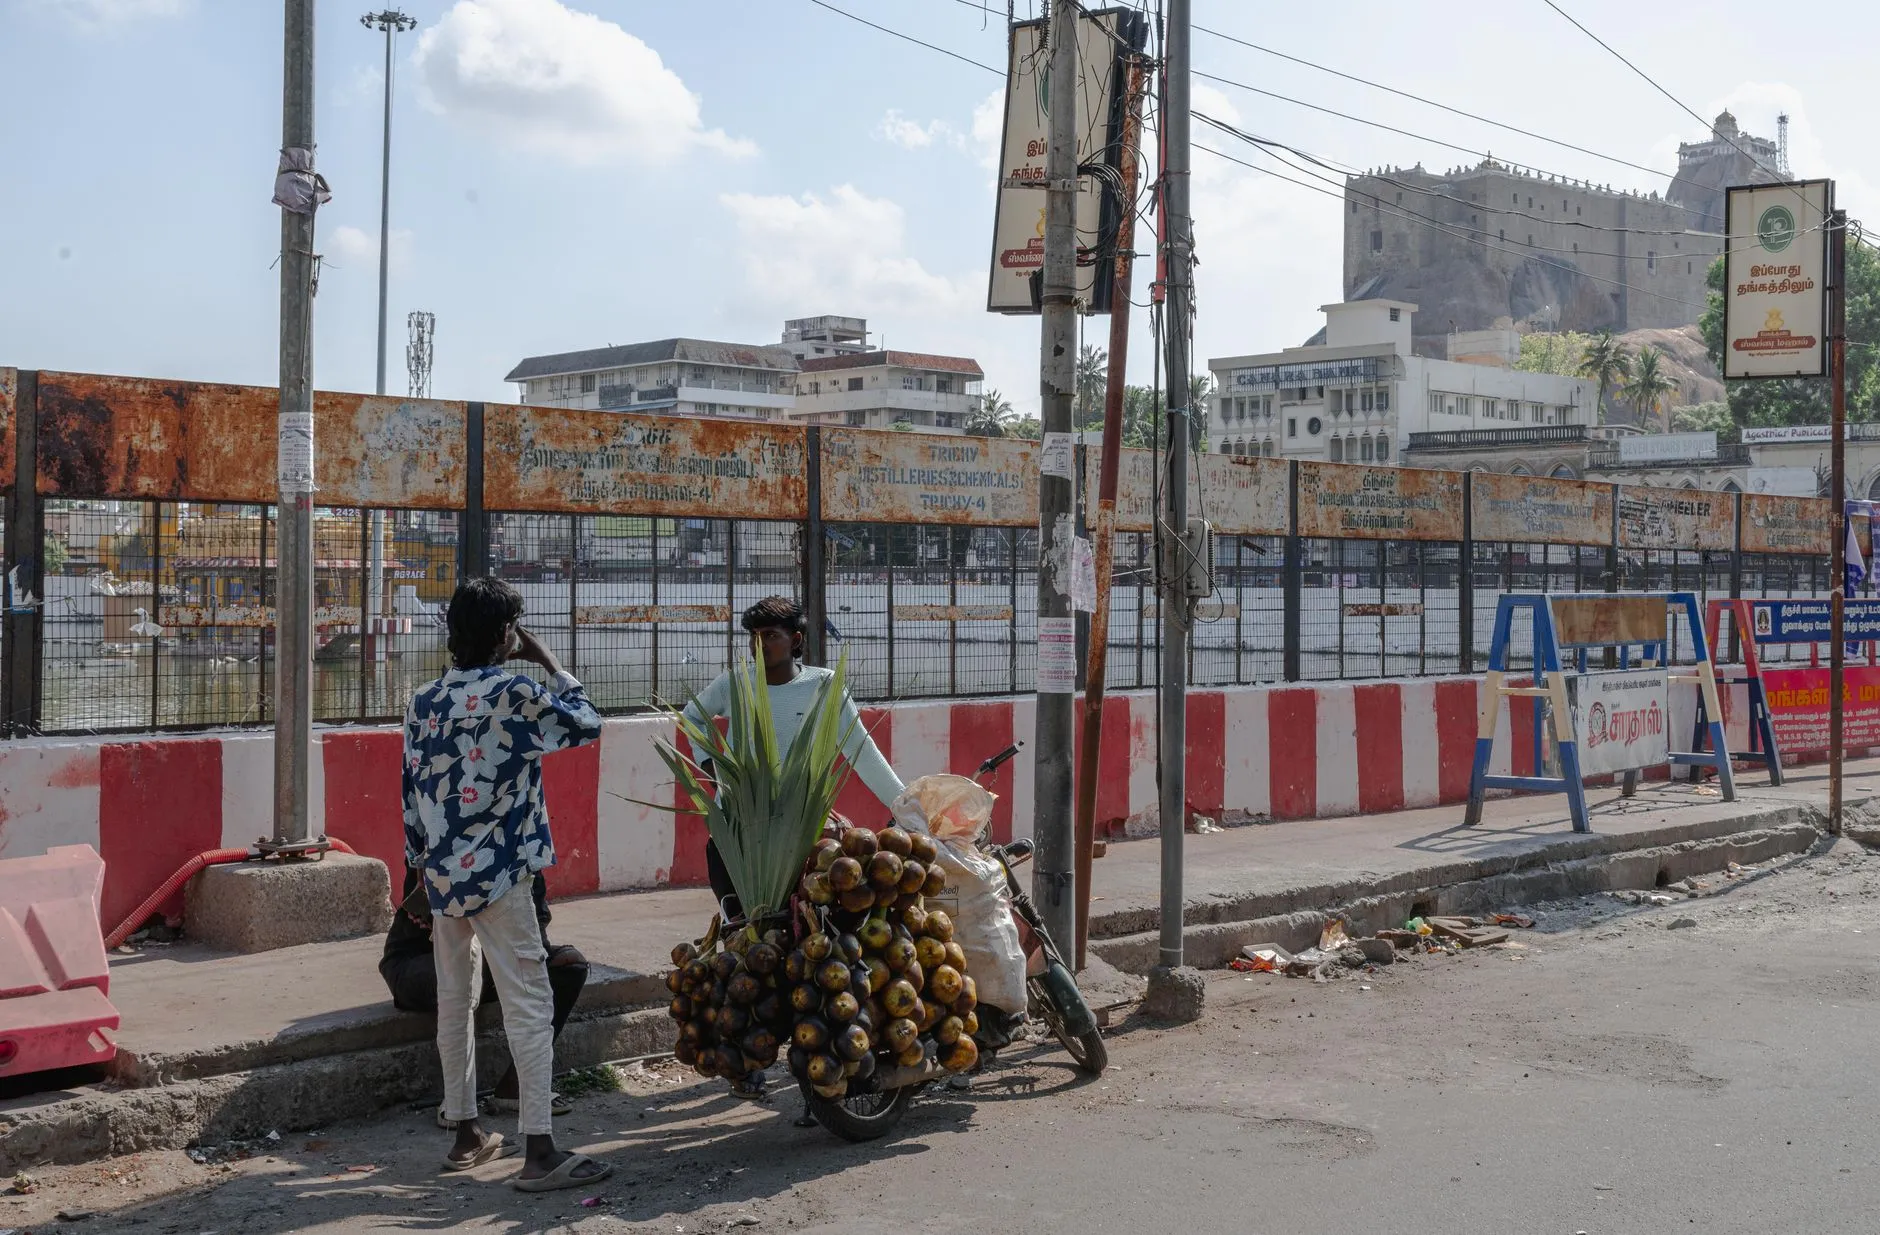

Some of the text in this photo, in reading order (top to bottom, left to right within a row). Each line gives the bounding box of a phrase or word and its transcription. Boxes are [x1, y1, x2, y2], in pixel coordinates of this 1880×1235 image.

[1750, 263, 1801, 278] இப்போது
[1736, 277, 1815, 296] தங்கத்திலும்
[1608, 699, 1663, 747] சாரதாஸ்
